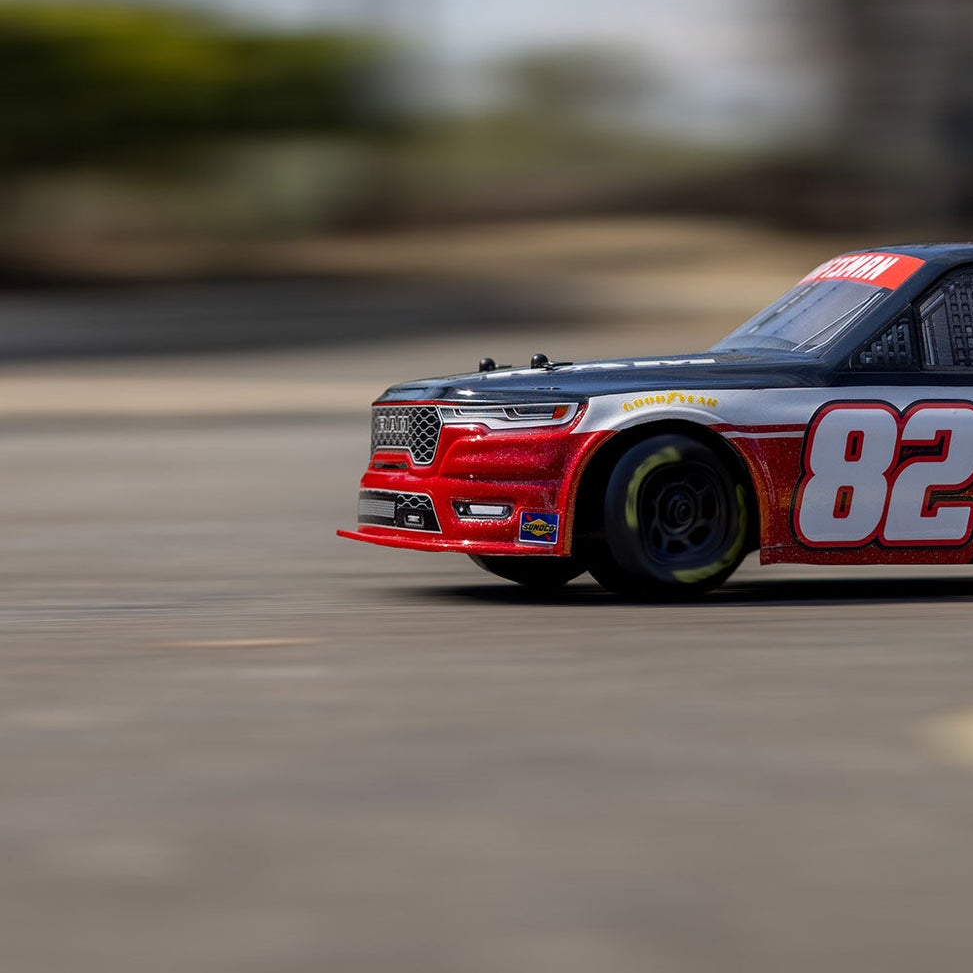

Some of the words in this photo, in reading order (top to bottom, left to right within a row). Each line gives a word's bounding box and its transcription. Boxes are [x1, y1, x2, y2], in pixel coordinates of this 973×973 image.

[622, 391, 719, 412] GOODYEAR
[376, 415, 409, 433] RAM
[522, 523, 557, 533] SUNOCO
